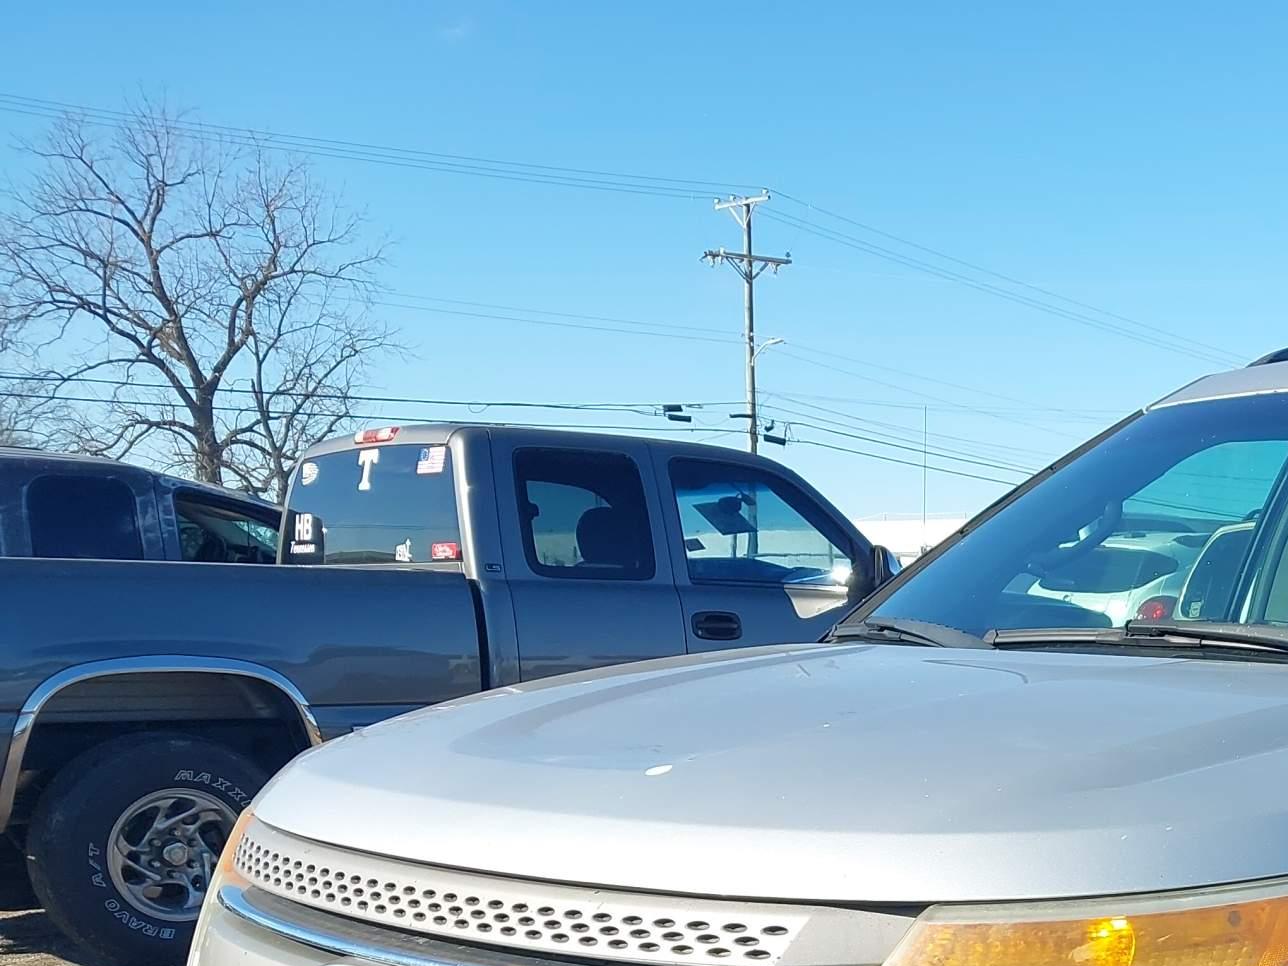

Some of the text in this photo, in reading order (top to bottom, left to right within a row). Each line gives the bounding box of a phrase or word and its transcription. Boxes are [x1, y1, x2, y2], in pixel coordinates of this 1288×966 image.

[358, 449, 379, 490] T
[295, 513, 312, 541] HB
[88, 842, 175, 939] BRAVO A/T
